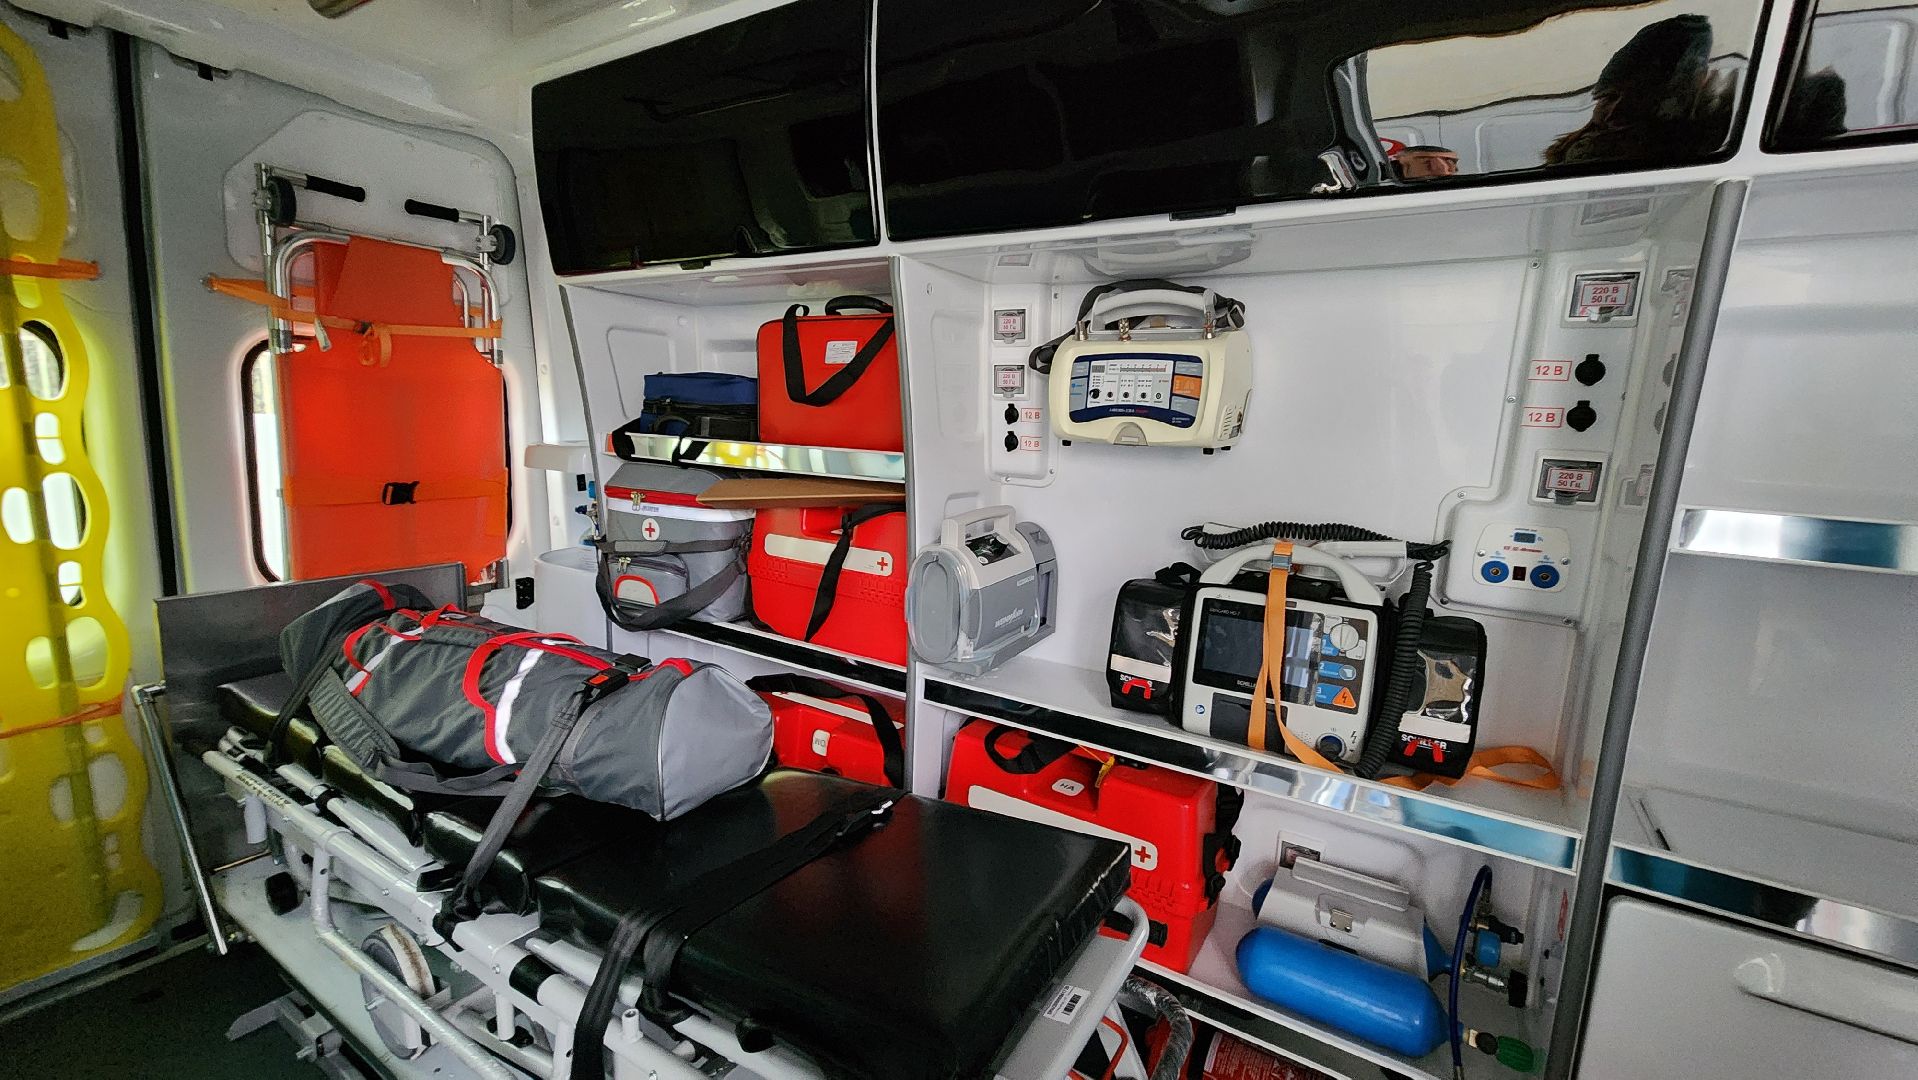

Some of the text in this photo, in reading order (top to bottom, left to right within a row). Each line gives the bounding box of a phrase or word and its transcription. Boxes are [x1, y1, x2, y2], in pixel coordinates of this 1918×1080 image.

[1592, 295, 1617, 303] 50 Гц
[1535, 365, 1563, 375] 12 В
[1025, 411, 1040, 420] 12 В
[1528, 412, 1556, 422] 12 В
[1034, 440, 1040, 448] В
[1558, 471, 1575, 479] 220
[1319, 662, 1325, 670] 2
